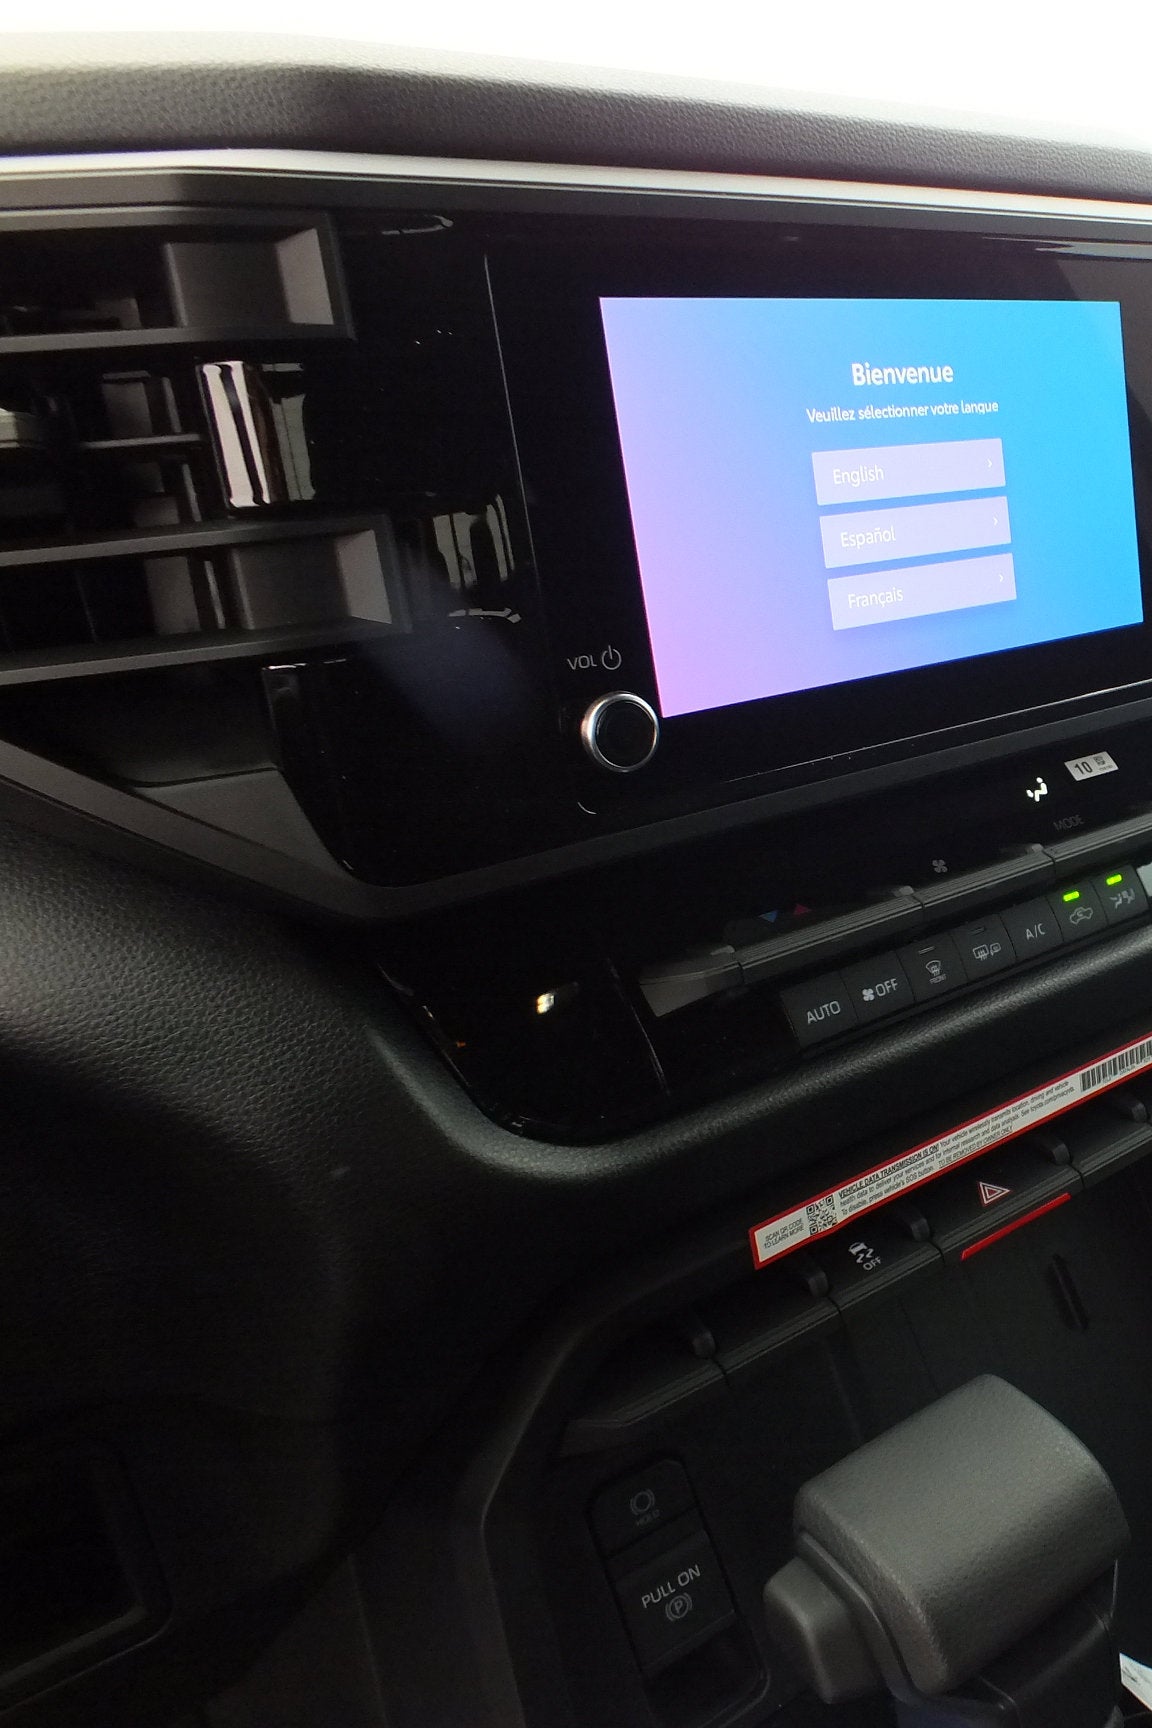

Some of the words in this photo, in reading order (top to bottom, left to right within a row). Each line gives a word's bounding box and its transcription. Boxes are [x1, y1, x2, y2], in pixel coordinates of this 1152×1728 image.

[852, 362, 954, 386] Bienvenue
[806, 406, 856, 423] Veuillez
[858, 404, 929, 420] sélectionner
[930, 403, 959, 416] votre
[960, 400, 999, 416] langue
[832, 465, 885, 487] English
[840, 525, 897, 549] Español
[847, 586, 904, 609] Français
[566, 654, 598, 670] VOL
[1074, 761, 1093, 775] 10
[1053, 814, 1085, 831] MODE
[1025, 922, 1046, 941] A/C
[875, 978, 898, 997] OFF
[806, 1000, 841, 1025] AUTO
[839, 1181, 863, 1198] VEHICLE
[864, 1173, 880, 1186] DATA
[881, 1152, 922, 1178] TRANSMISSION
[641, 1581, 676, 1609] PULL
[677, 1563, 701, 1587] ON
